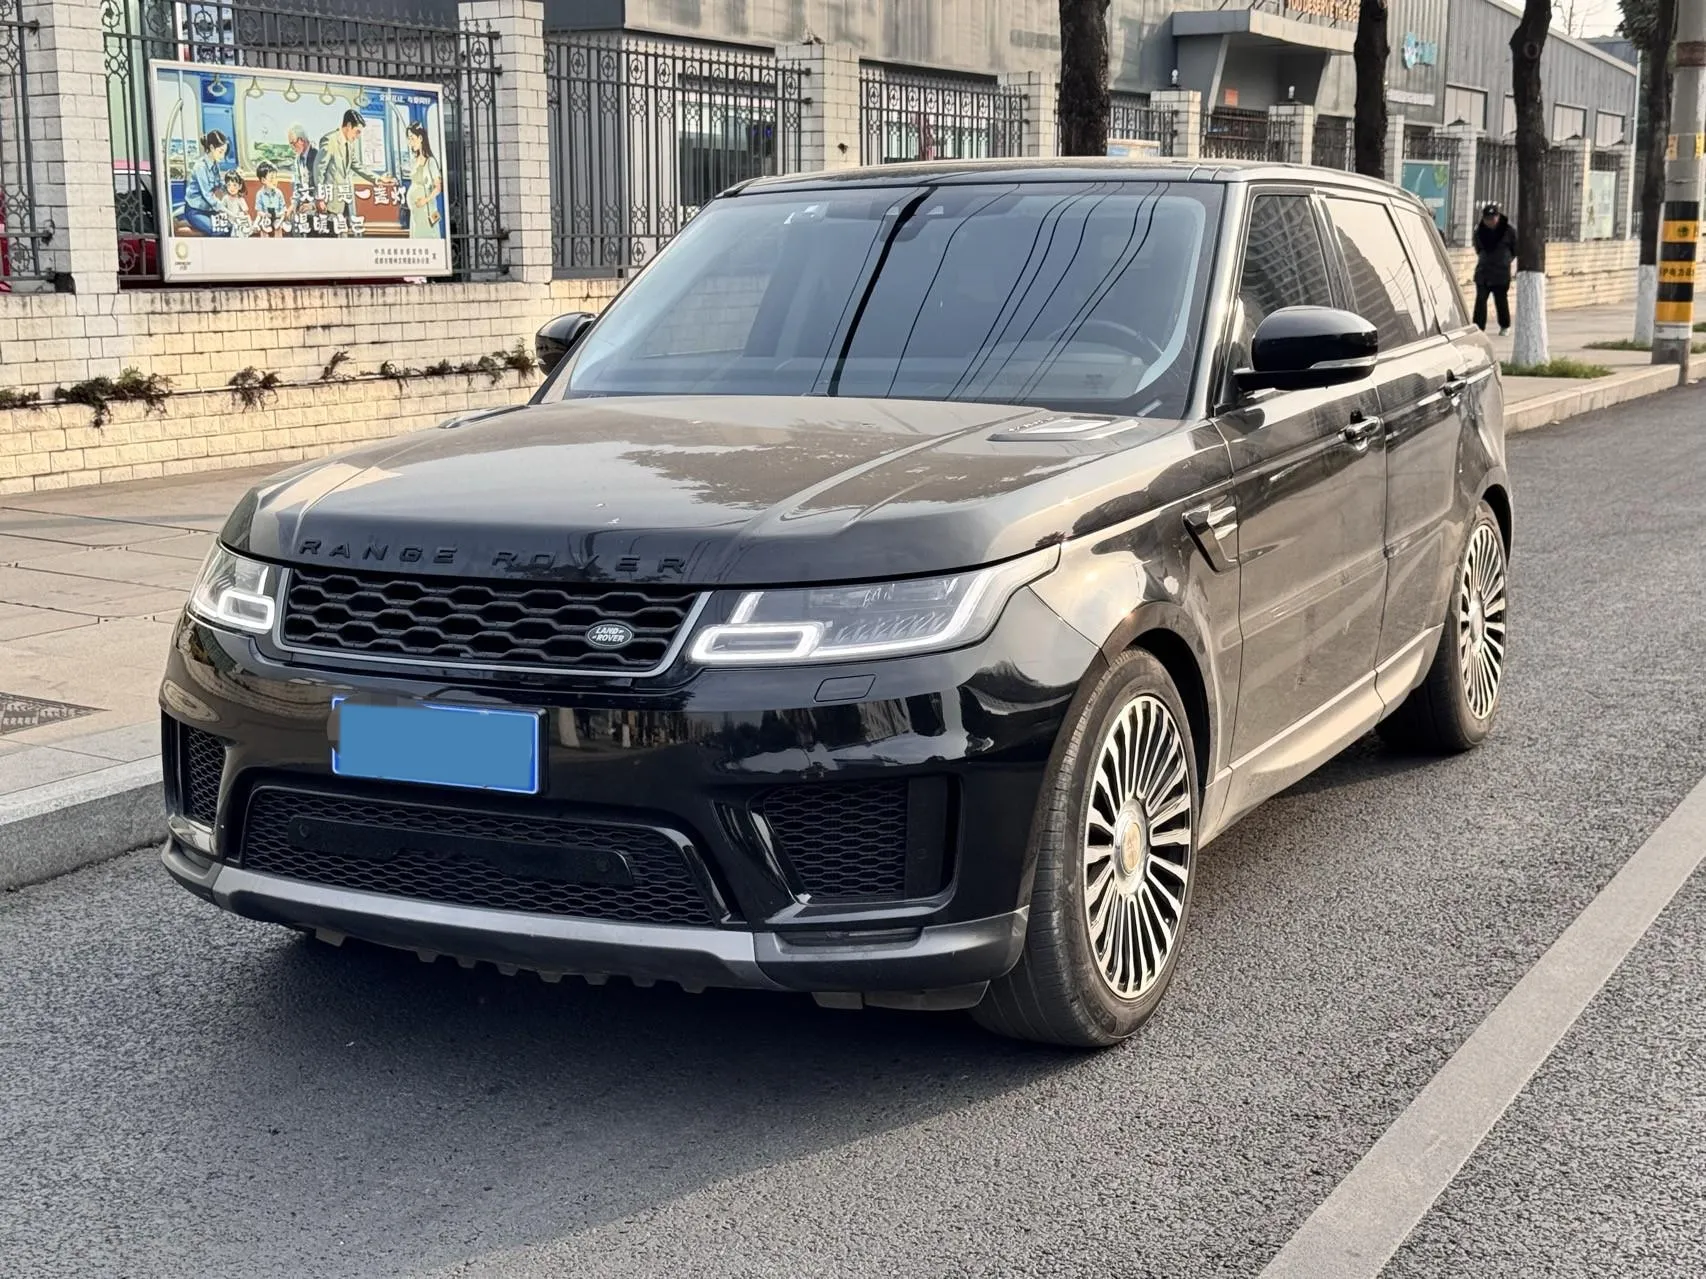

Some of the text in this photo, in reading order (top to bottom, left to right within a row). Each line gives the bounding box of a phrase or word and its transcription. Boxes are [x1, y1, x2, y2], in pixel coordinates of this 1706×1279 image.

[300, 183, 406, 204] 文明是一盏灯
[211, 213, 366, 234] 照亮他人温暖自己
[299, 540, 686, 574] RANGE ROVER
[596, 627, 619, 635] LAND
[596, 634, 625, 642] ROVER
